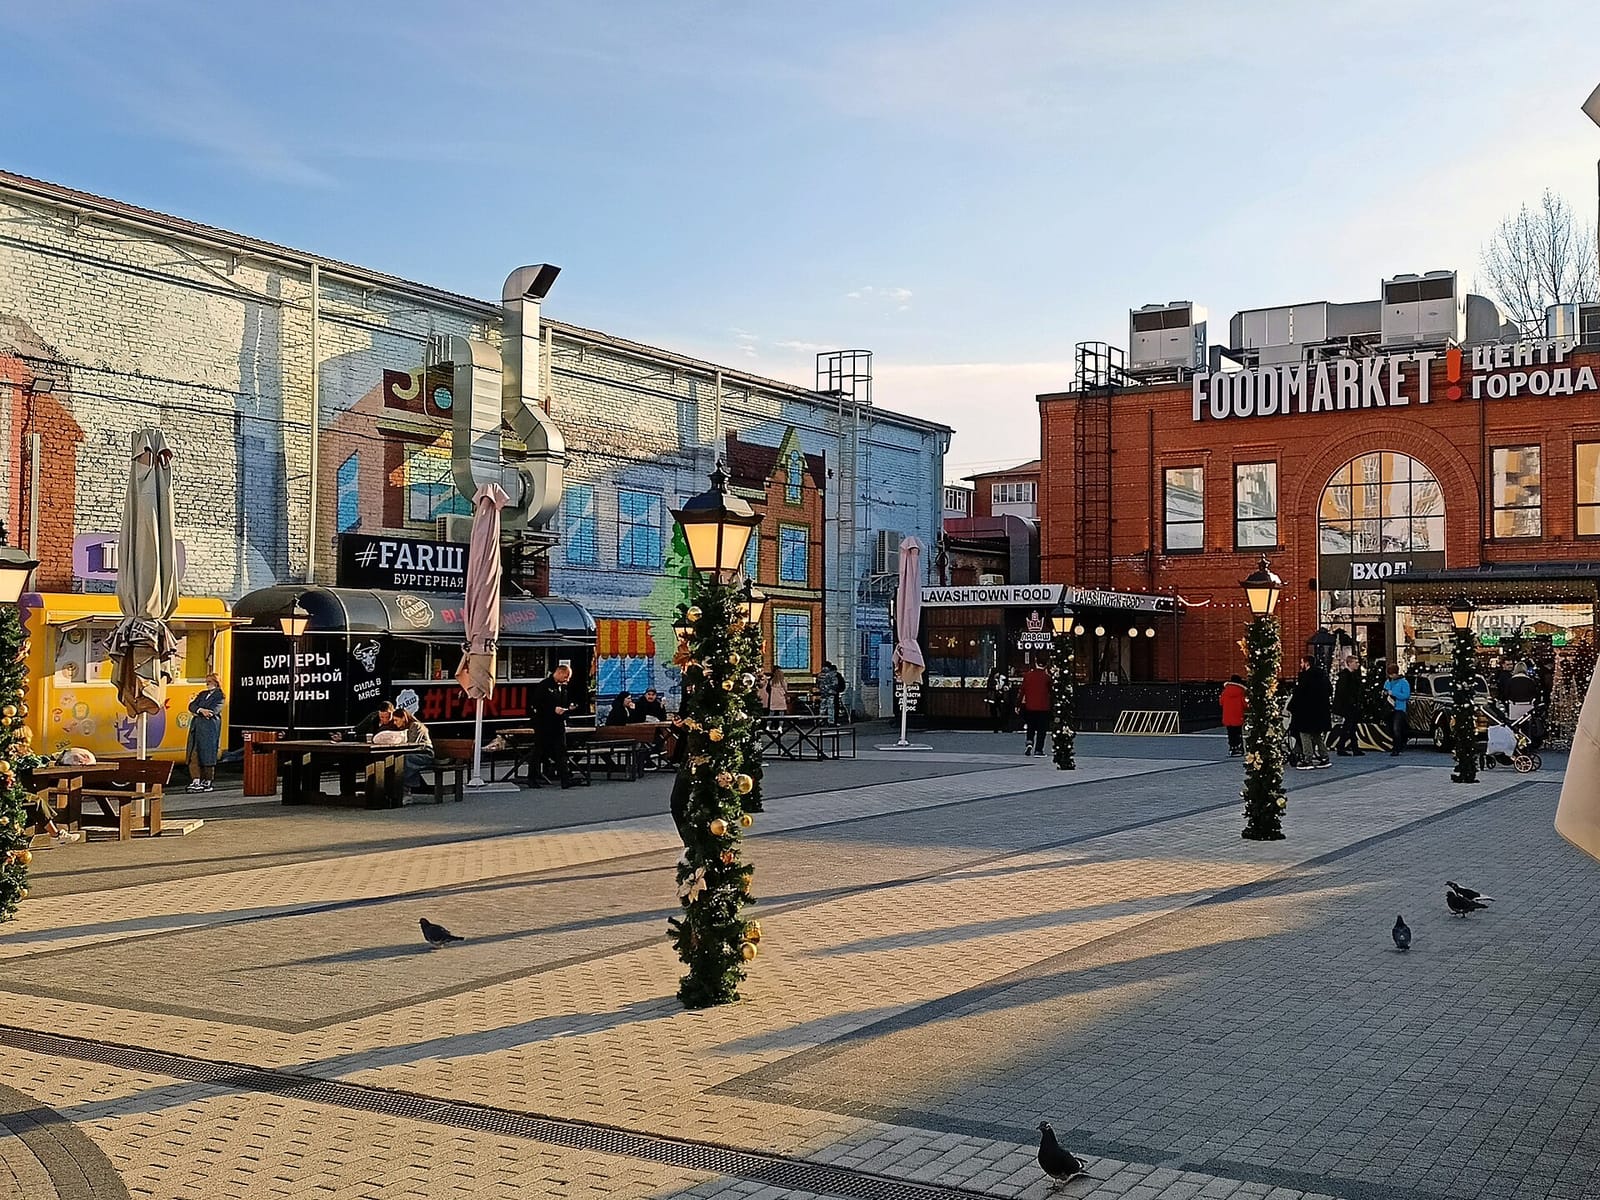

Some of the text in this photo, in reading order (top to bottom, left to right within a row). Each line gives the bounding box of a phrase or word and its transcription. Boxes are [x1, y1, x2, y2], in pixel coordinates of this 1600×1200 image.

[1472, 339, 1575, 371] ЦЕНТР
[1472, 366, 1598, 399] ГОРОДА
[355, 541, 464, 573] #FARШ
[1353, 562, 1407, 579] ВХОД
[394, 573, 464, 588] БУРГЕРНАЯ
[921, 588, 1051, 602] LAVASHTOWN FOOD
[241, 677, 254, 687] из
[353, 677, 382, 692] СИЛА В
[358, 688, 381, 701] МЯСЕ
